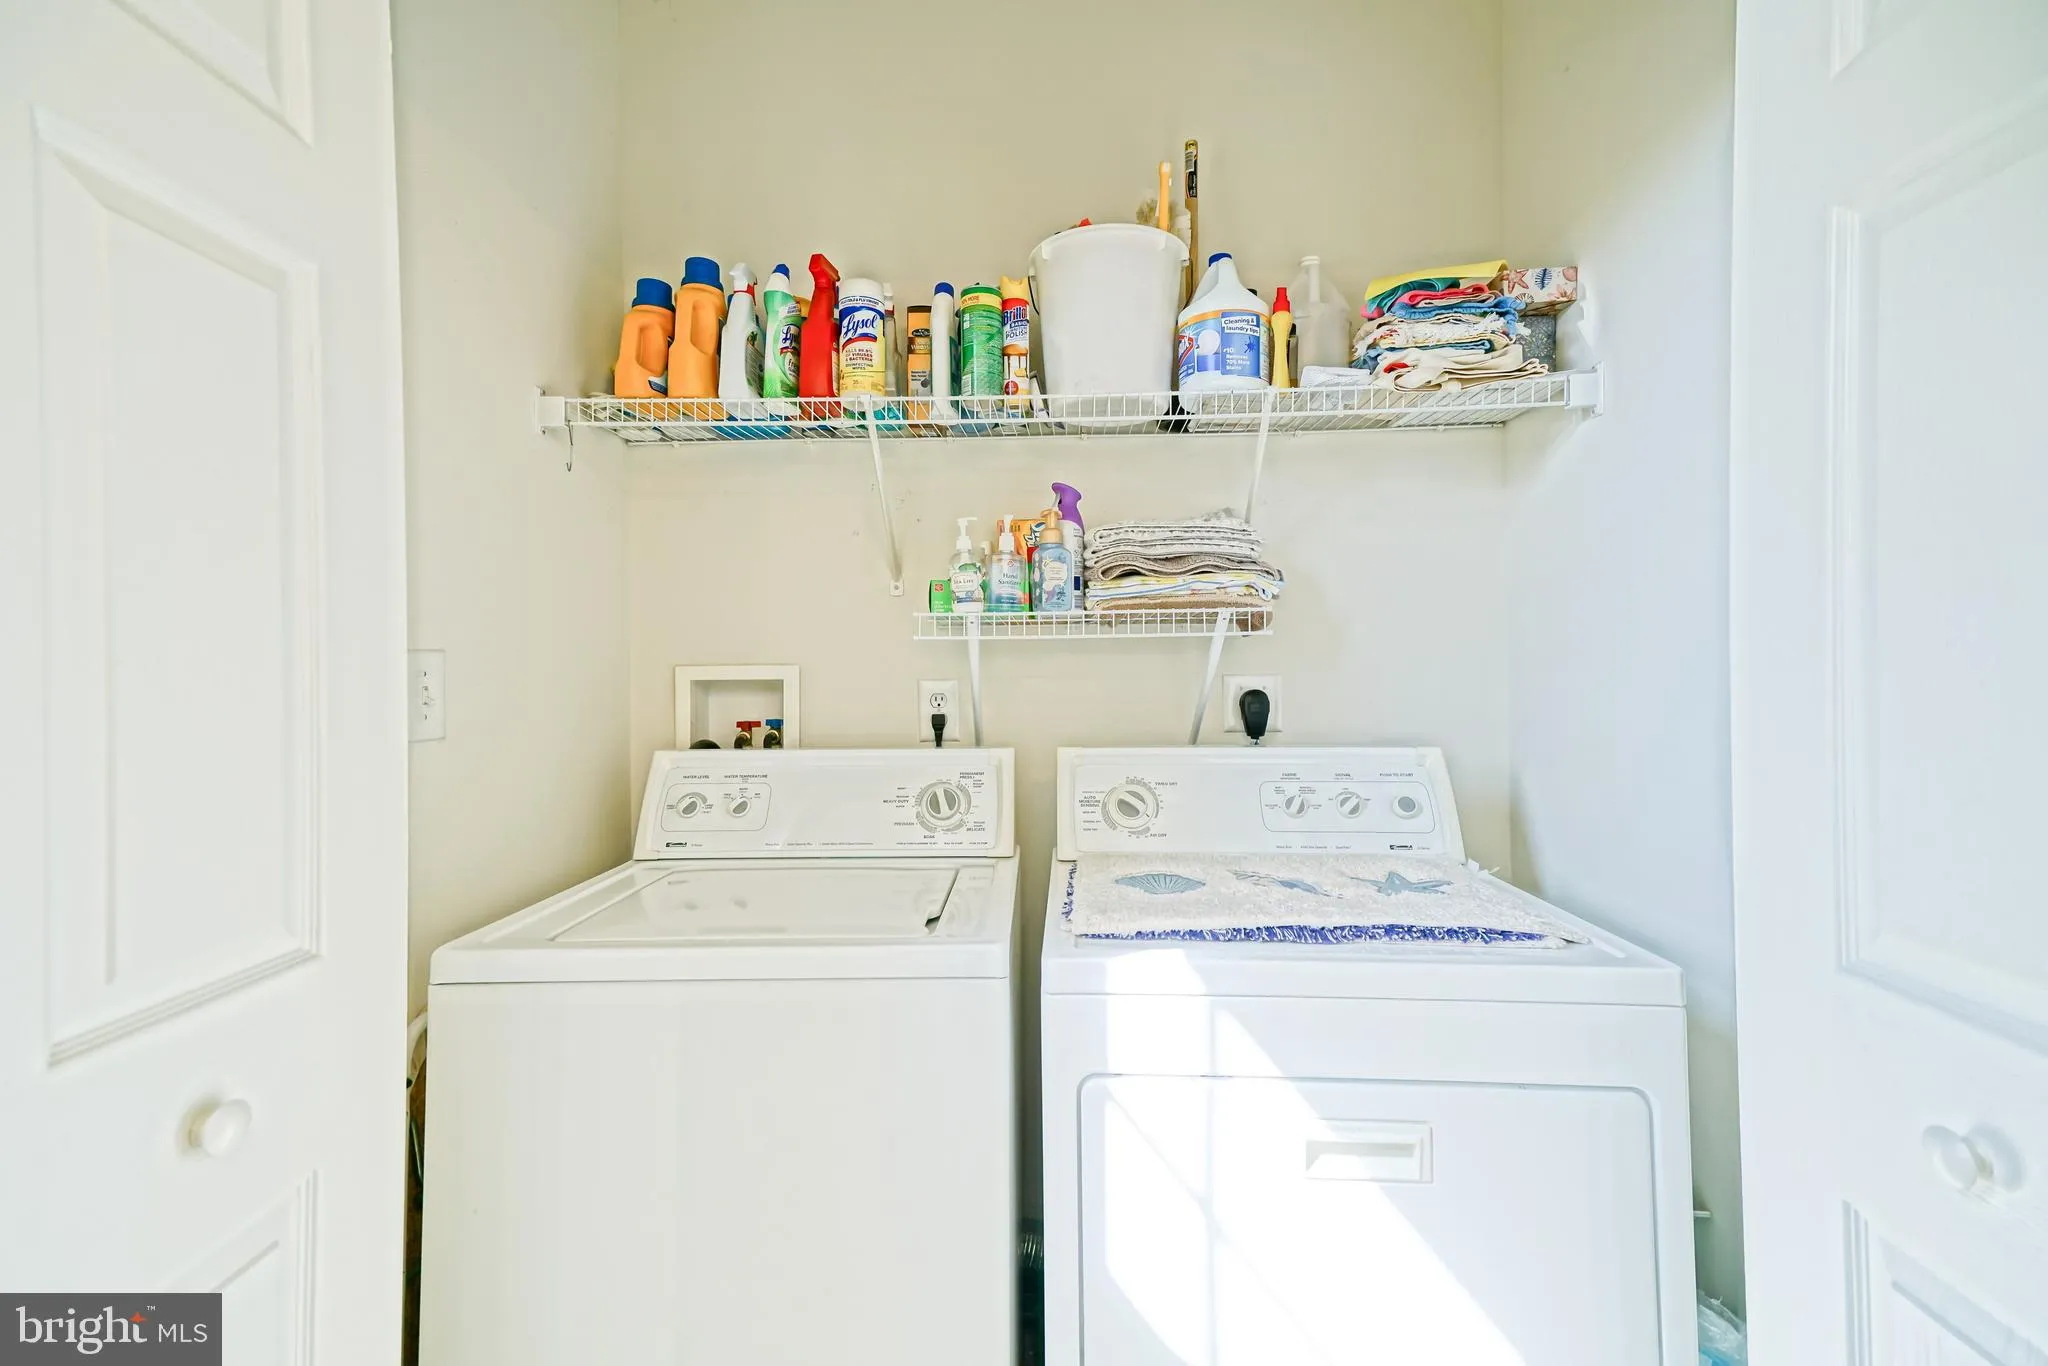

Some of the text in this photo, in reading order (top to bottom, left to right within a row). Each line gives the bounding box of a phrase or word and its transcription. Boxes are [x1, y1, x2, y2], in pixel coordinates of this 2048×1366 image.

[843, 313, 877, 339] Lysol
[1003, 306, 1028, 326] Brillo
[1005, 330, 1027, 340] POLISH
